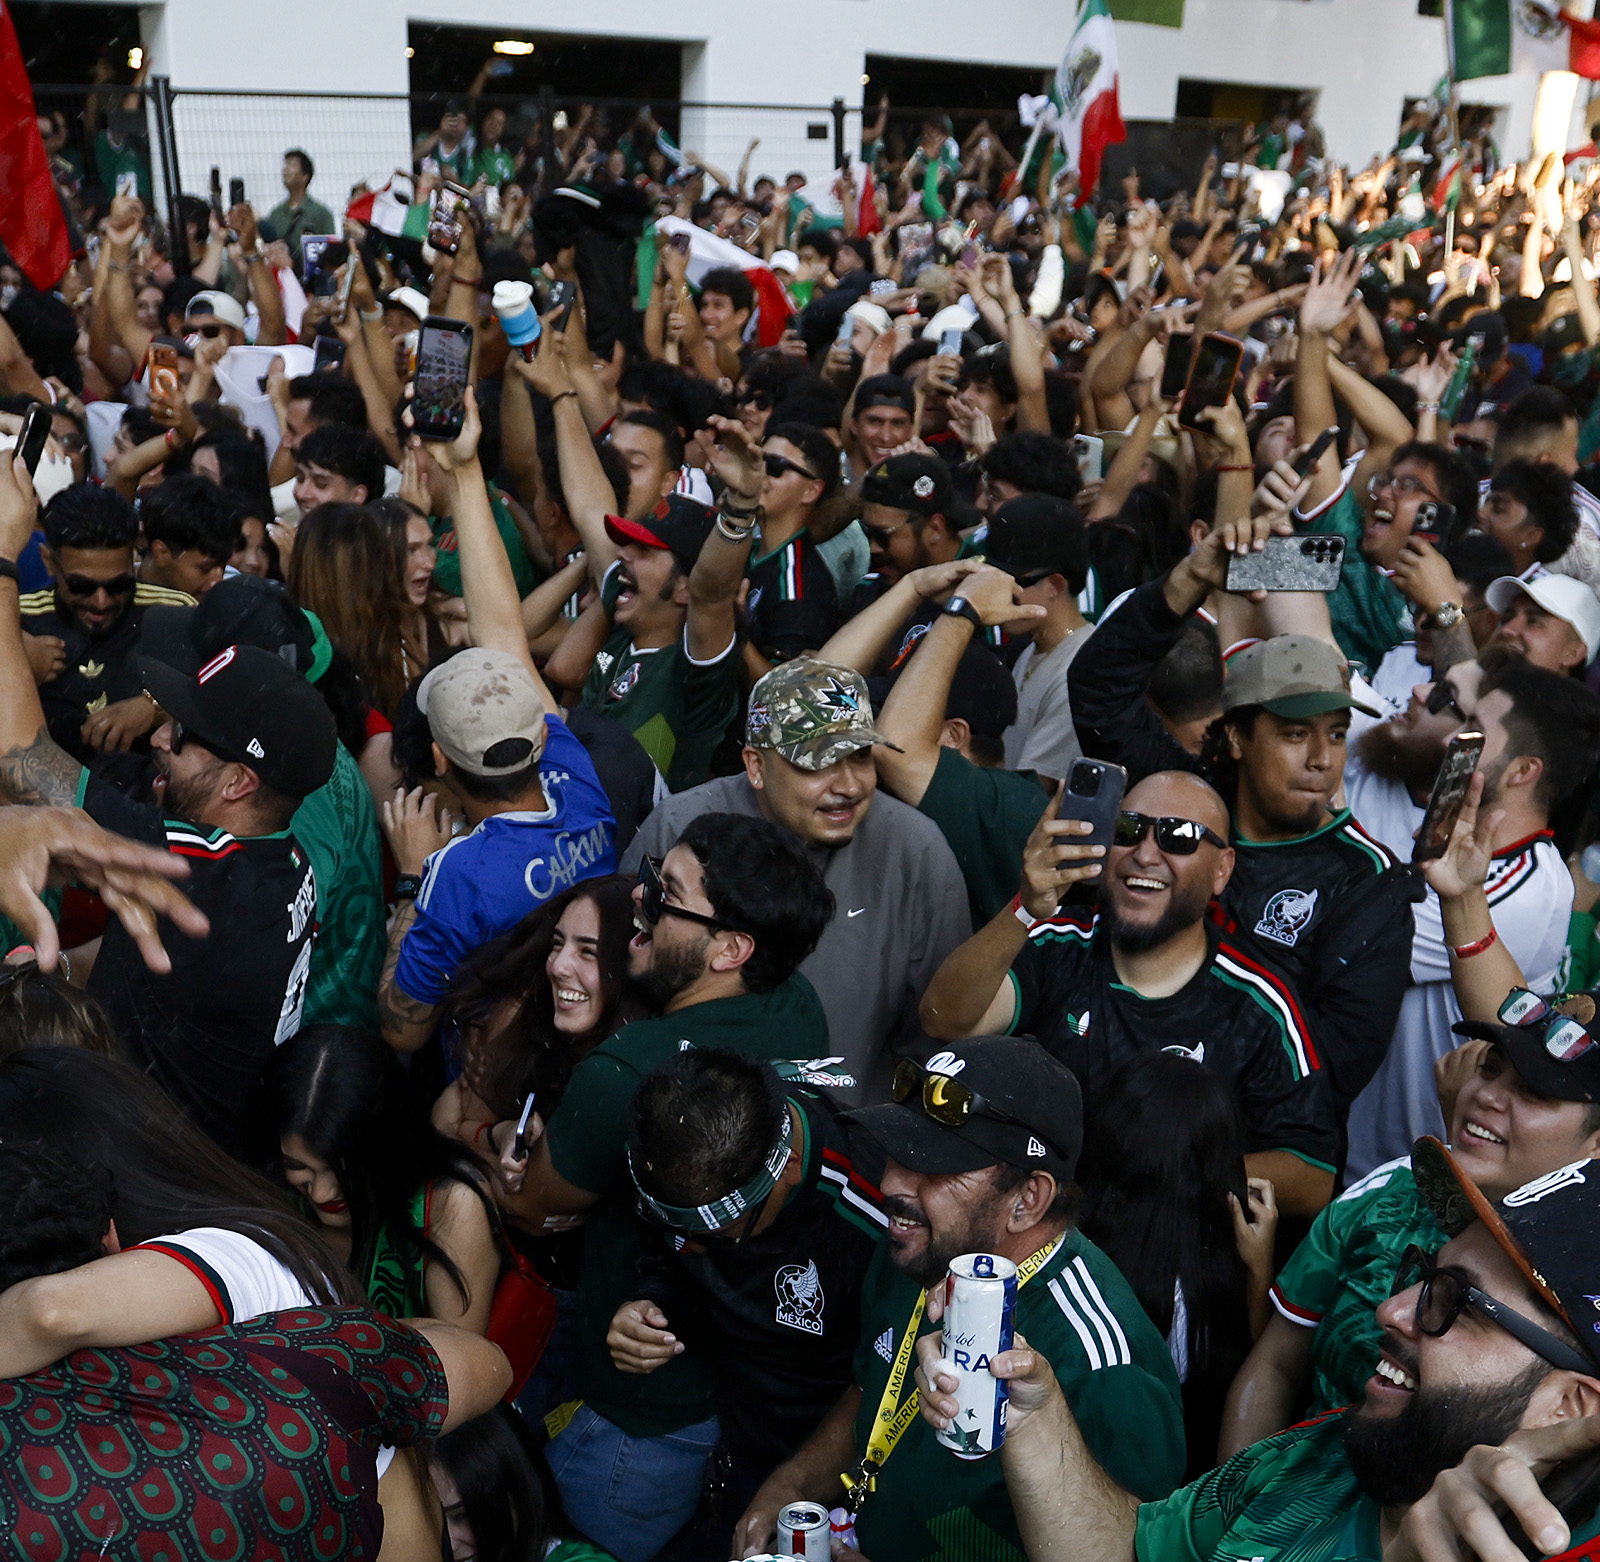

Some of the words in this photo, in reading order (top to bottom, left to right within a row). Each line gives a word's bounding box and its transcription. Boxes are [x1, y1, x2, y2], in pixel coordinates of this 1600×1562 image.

[1258, 922, 1294, 942] MÉXICO
[778, 1309, 821, 1332] MÉXICO
[889, 1329, 916, 1399] AMERICA
